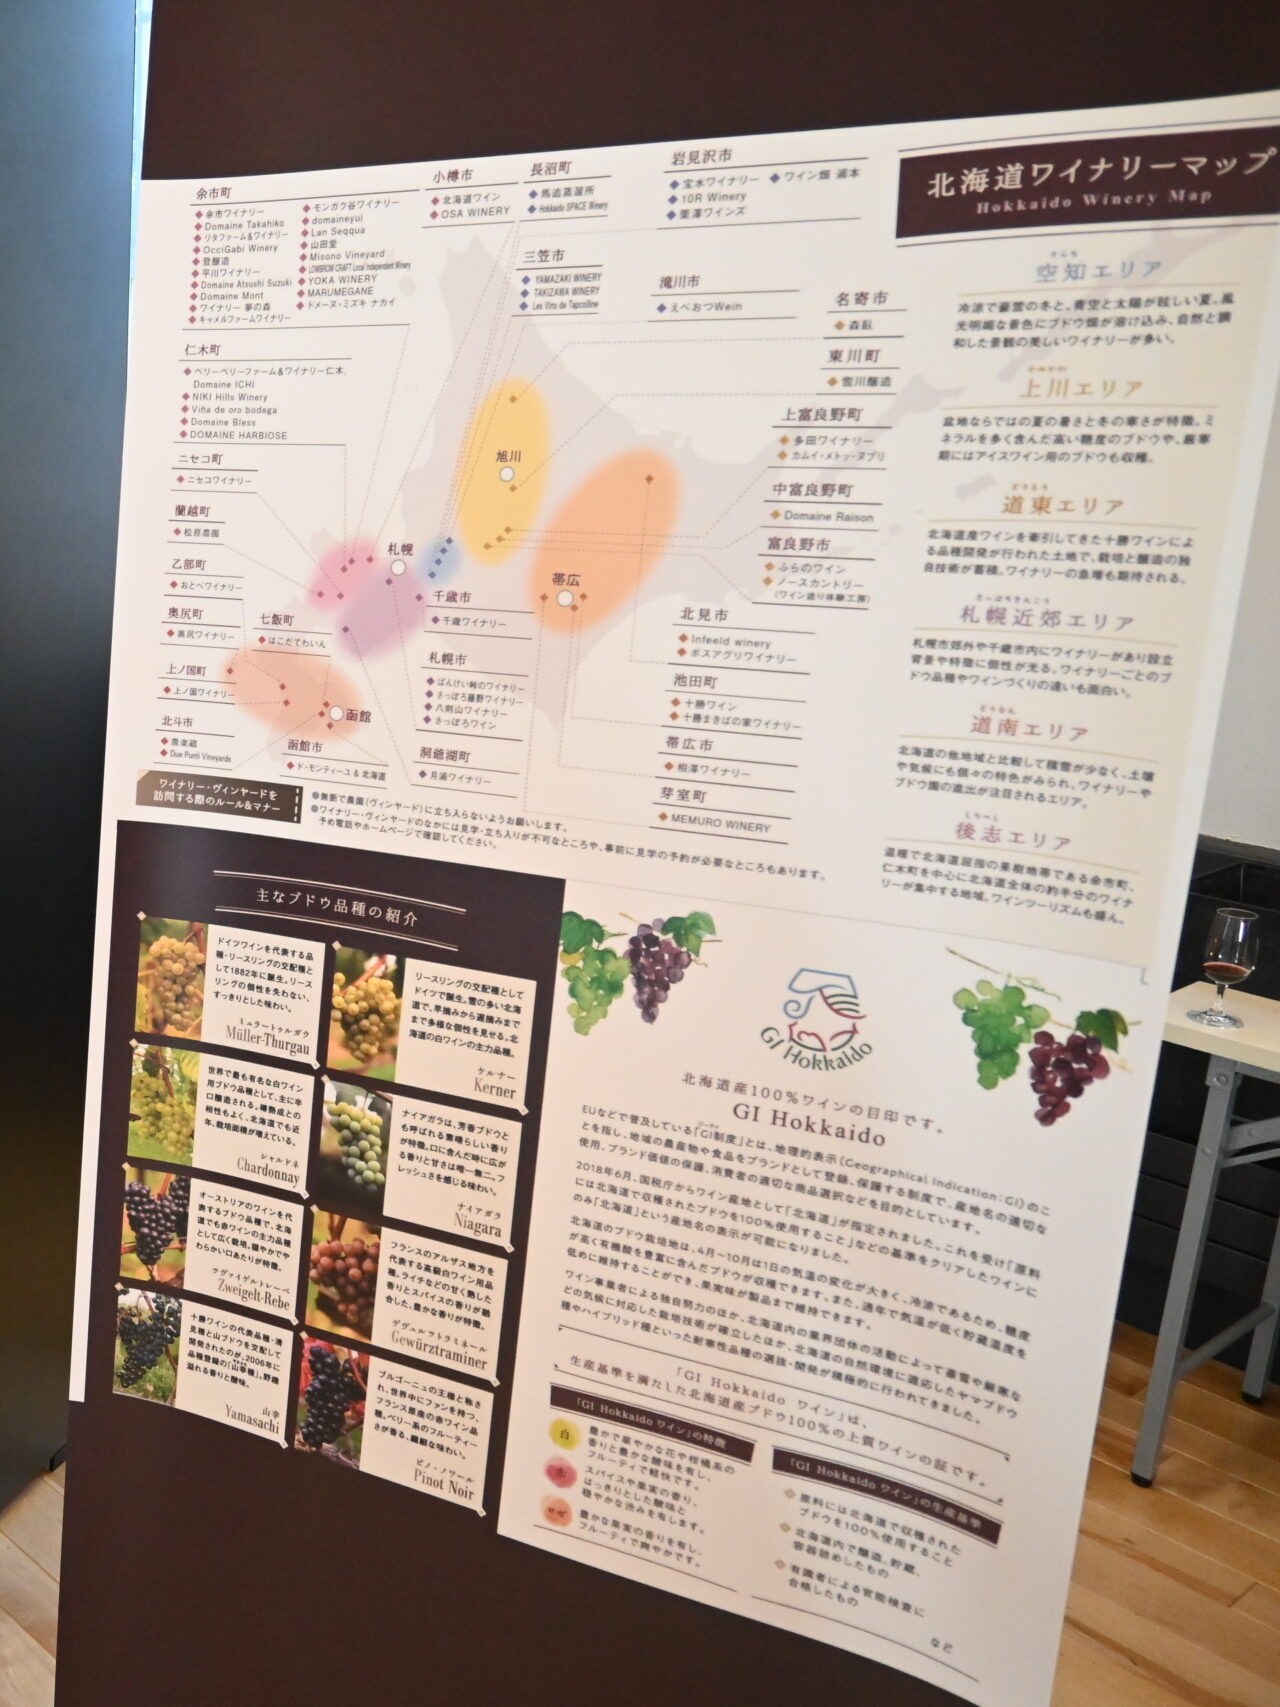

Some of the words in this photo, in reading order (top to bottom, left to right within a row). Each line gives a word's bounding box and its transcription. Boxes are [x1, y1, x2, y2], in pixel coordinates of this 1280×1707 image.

[671, 148, 733, 166] 岩見沢市
[530, 161, 572, 176] 長沼町
[927, 147, 1278, 199] 北海道ワイナリーマップ
[433, 169, 473, 183] 小樽市
[682, 176, 759, 189] 宝水ワイナリー
[196, 187, 232, 200] 余市町
[443, 192, 501, 205] 北海道ワイン
[682, 194, 702, 203] 10R
[707, 192, 747, 202] Winery
[314, 199, 400, 212] モンガク谷ワイナリー
[976, 196, 1071, 214] Hokkaido
[1083, 191, 1158, 207] Winery
[1169, 188, 1212, 204] Map
[206, 209, 264, 218] 余市ワイナリー
[442, 209, 463, 219] OSA
[469, 206, 510, 217] WINERY
[205, 222, 242, 230] Domaine
[247, 220, 284, 229] Takahiko
[312, 215, 363, 225] domaineyui
[203, 245, 244, 254] OcciGabi
[249, 245, 277, 254] Winery
[311, 240, 337, 249] 山田堂
[310, 252, 341, 261] Misono
[345, 250, 385, 260] Vineyard
[523, 249, 565, 263] 三笠市
[202, 268, 260, 278] 平川ワイナリー
[1035, 260, 1162, 283] 空知エリア
[201, 281, 234, 289] Domaine
[237, 280, 264, 288] Atsushi
[267, 279, 292, 287] Suzuki
[308, 277, 335, 286] YOKA
[339, 275, 378, 284] WINERY
[536, 274, 571, 284] YAMAZAKI
[573, 273, 602, 282] WINERY
[659, 275, 700, 289] 滝川市
[201, 293, 238, 301] Domaine
[242, 292, 263, 300] Mont
[307, 287, 373, 297] MARUMEGANE
[534, 288, 569, 297] TAKIZAWA
[572, 286, 600, 295] WINERY
[836, 291, 888, 306] 名寄市
[200, 304, 240, 312] ワイナリー
[245, 303, 270, 311] 夢の森
[670, 302, 742, 312] えべおつWein
[199, 314, 291, 324] キャメルファームワイナリー
[185, 344, 221, 356] 仁木町
[828, 349, 881, 363] 東川町
[193, 380, 231, 389] Domaine
[1019, 378, 1143, 399] 上川エリア
[192, 393, 211, 401] NIKI
[238, 393, 268, 402] Winery
[192, 406, 211, 414] Viña
[215, 406, 225, 414] de
[245, 407, 277, 415] bodega
[782, 408, 863, 422] 上富良野町
[191, 418, 229, 426] Domaine
[233, 418, 256, 426] Bless
[190, 431, 235, 439] DOMAINE
[239, 431, 287, 440] HARBIOSE
[794, 436, 873, 446] 多田ワイナリー
[178, 454, 223, 465] ニセコ町
[496, 450, 522, 462] 旭川
[188, 476, 252, 485] ニセコワイナリー
[773, 483, 854, 498] 中富良野町
[175, 505, 211, 517] 蘭越町
[1001, 494, 1124, 516] 道東エリア
[784, 511, 831, 521] Domaine
[836, 512, 873, 522] Raison
[184, 528, 220, 538] 松原農園
[388, 542, 414, 556] 札幌
[768, 537, 831, 551] 富良野市
[172, 559, 207, 570] 乙部町
[778, 563, 846, 574] ふらのワイン
[181, 581, 242, 591] おとべワイナリー
[552, 573, 581, 587] 帯広
[777, 578, 864, 589] ノースカントリー
[433, 590, 471, 603] 千歳市
[168, 607, 204, 620] 奥尻町
[260, 613, 294, 626] 七飯町
[680, 607, 729, 622] 北見市
[960, 605, 1134, 632] 札幌近郊エリア
[443, 617, 506, 628] 千歳ワイナリー
[178, 630, 235, 640] 奥尻ワイナリー
[269, 637, 326, 648] はこだてわいん
[691, 635, 729, 646] Infeeld
[735, 639, 771, 649] winery
[429, 651, 467, 665] 札幌市
[166, 664, 207, 676] 上ノ国町
[674, 673, 718, 689] 池田町
[173, 687, 234, 699] 上ノ国ワイナリー
[436, 704, 509, 718] 八剣山ワイナリー
[685, 699, 737, 711] 十勝ワイン
[162, 716, 193, 727] 北斗市
[346, 709, 371, 723] 函館
[435, 717, 496, 730] さっぽろワイン
[970, 716, 1088, 743] 道南エリア
[288, 739, 323, 753] 函館市
[667, 736, 714, 752] 帯広市
[420, 746, 471, 763] 洞爺湖町
[677, 763, 751, 778] 相澤ワイナリー
[430, 771, 492, 785] 月浦ワイナリー
[159, 779, 278, 800] ワイナリー・ヴィンヤードを
[661, 787, 707, 803] 芽室町
[672, 814, 721, 828] MEMURO
[726, 820, 770, 833] WINERY
[955, 822, 1071, 850] 後志エリア
[256, 888, 418, 927] 主なブドウ品種の紹介
[217, 937, 314, 961] ドイツワインを代表する品
[226, 1025, 310, 1056] Müller-Thurgau
[760, 1026, 784, 1049] GI
[783, 1041, 873, 1071] Hokkaido
[208, 1066, 303, 1092] 世界で最も有名な白ワイン
[474, 1077, 516, 1099] Kerner
[733, 1103, 760, 1122] GI
[771, 1108, 886, 1147] Hokkaido
[237, 1157, 300, 1188] Chardonnay
[199, 1191, 293, 1222] オーストリアのワインを代
[454, 1212, 502, 1237] Niagara
[391, 1241, 495, 1276] フランスのアルザス地方を
[218, 1278, 290, 1310] Zweigelt-Rebe
[392, 1330, 488, 1370] Gewürztraminer
[225, 1404, 279, 1434] Yamasachi
[414, 1468, 444, 1490] Pinot
[448, 1480, 474, 1500] Noir
[930, 1637, 953, 1655] など
